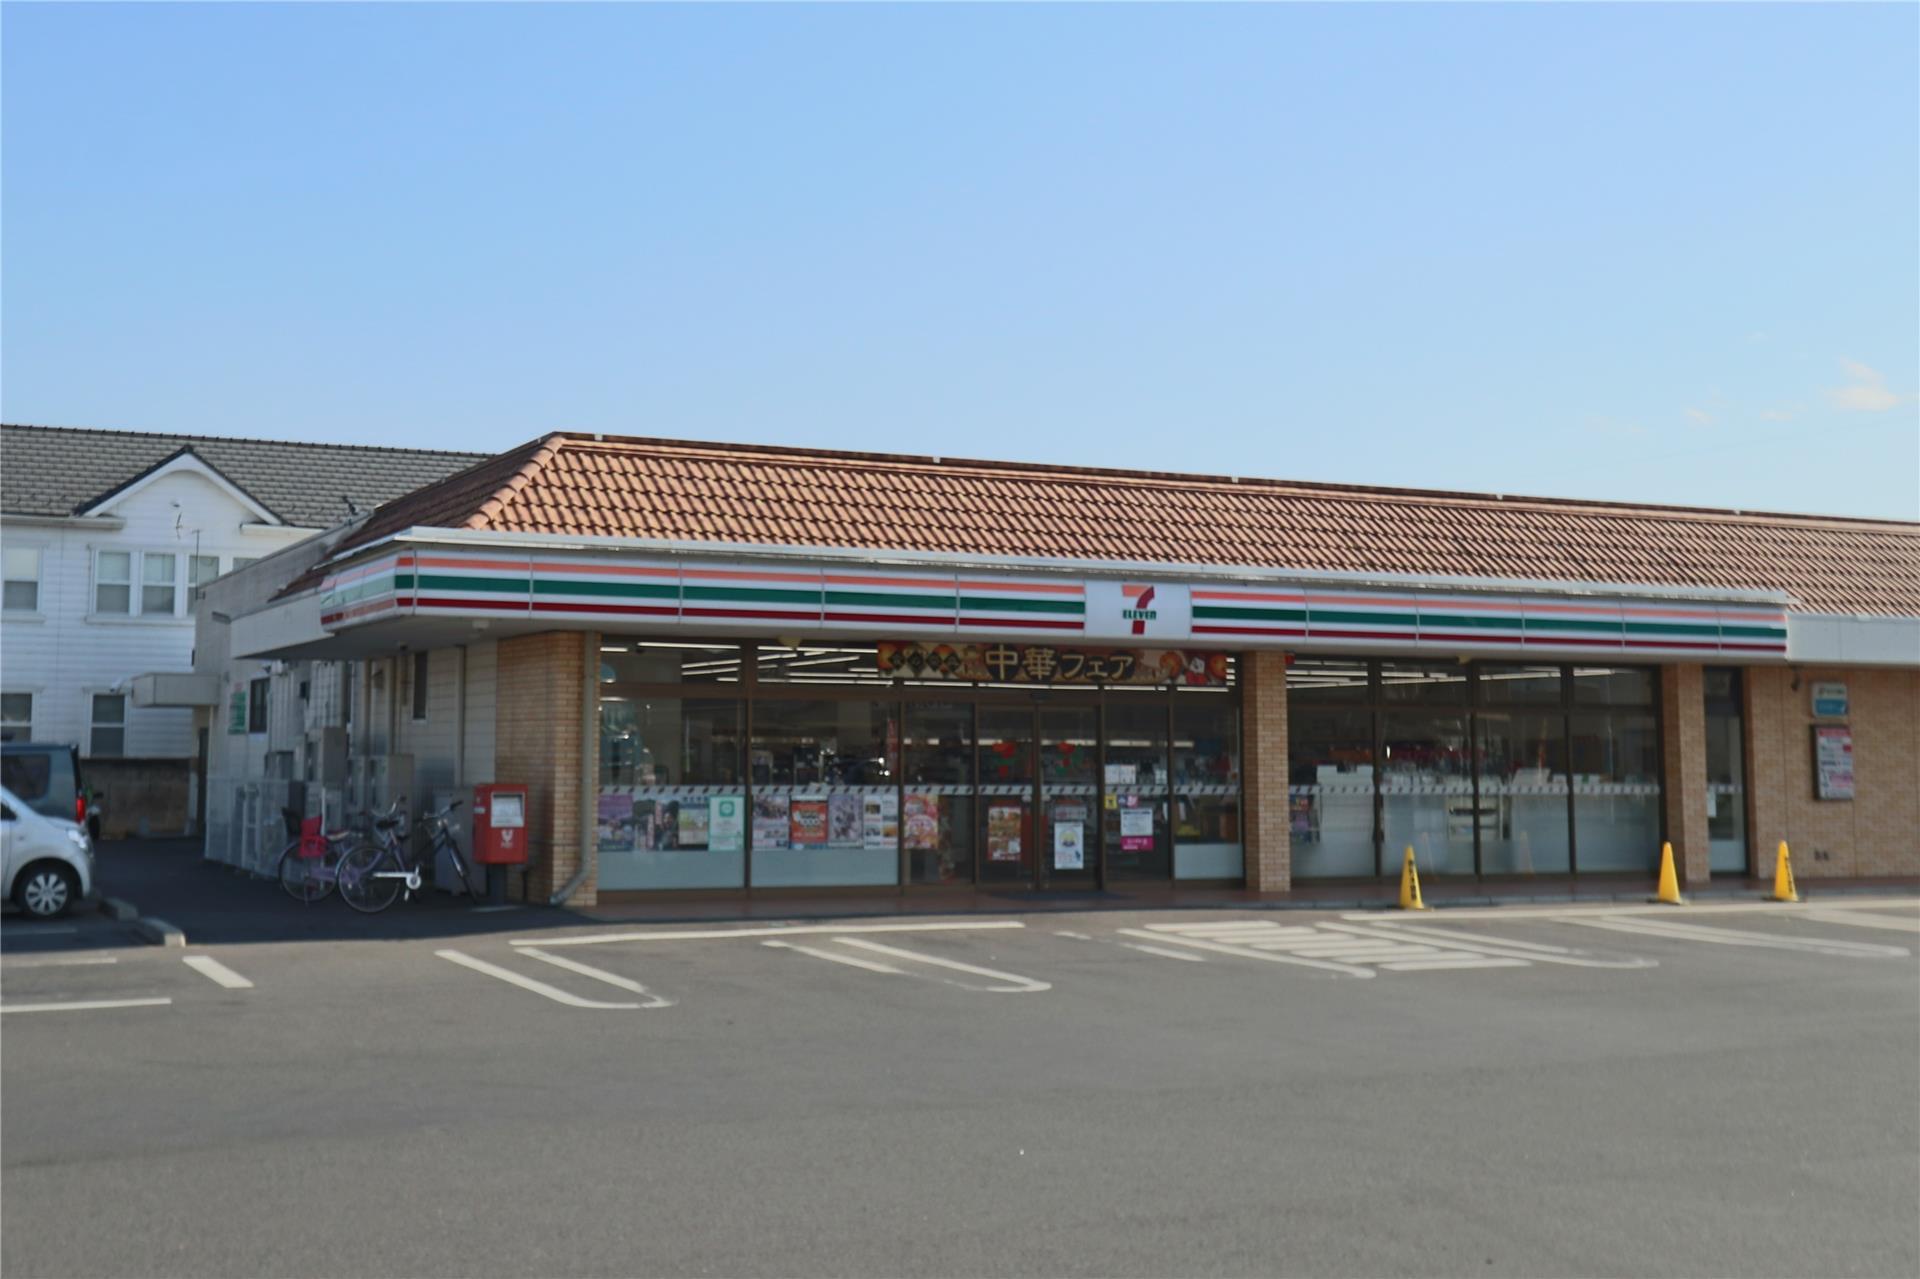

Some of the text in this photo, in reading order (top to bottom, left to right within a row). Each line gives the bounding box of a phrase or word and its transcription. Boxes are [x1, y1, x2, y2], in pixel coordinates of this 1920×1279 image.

[1122, 584, 1155, 635] 7
[985, 643, 1133, 680] 中華フェア
